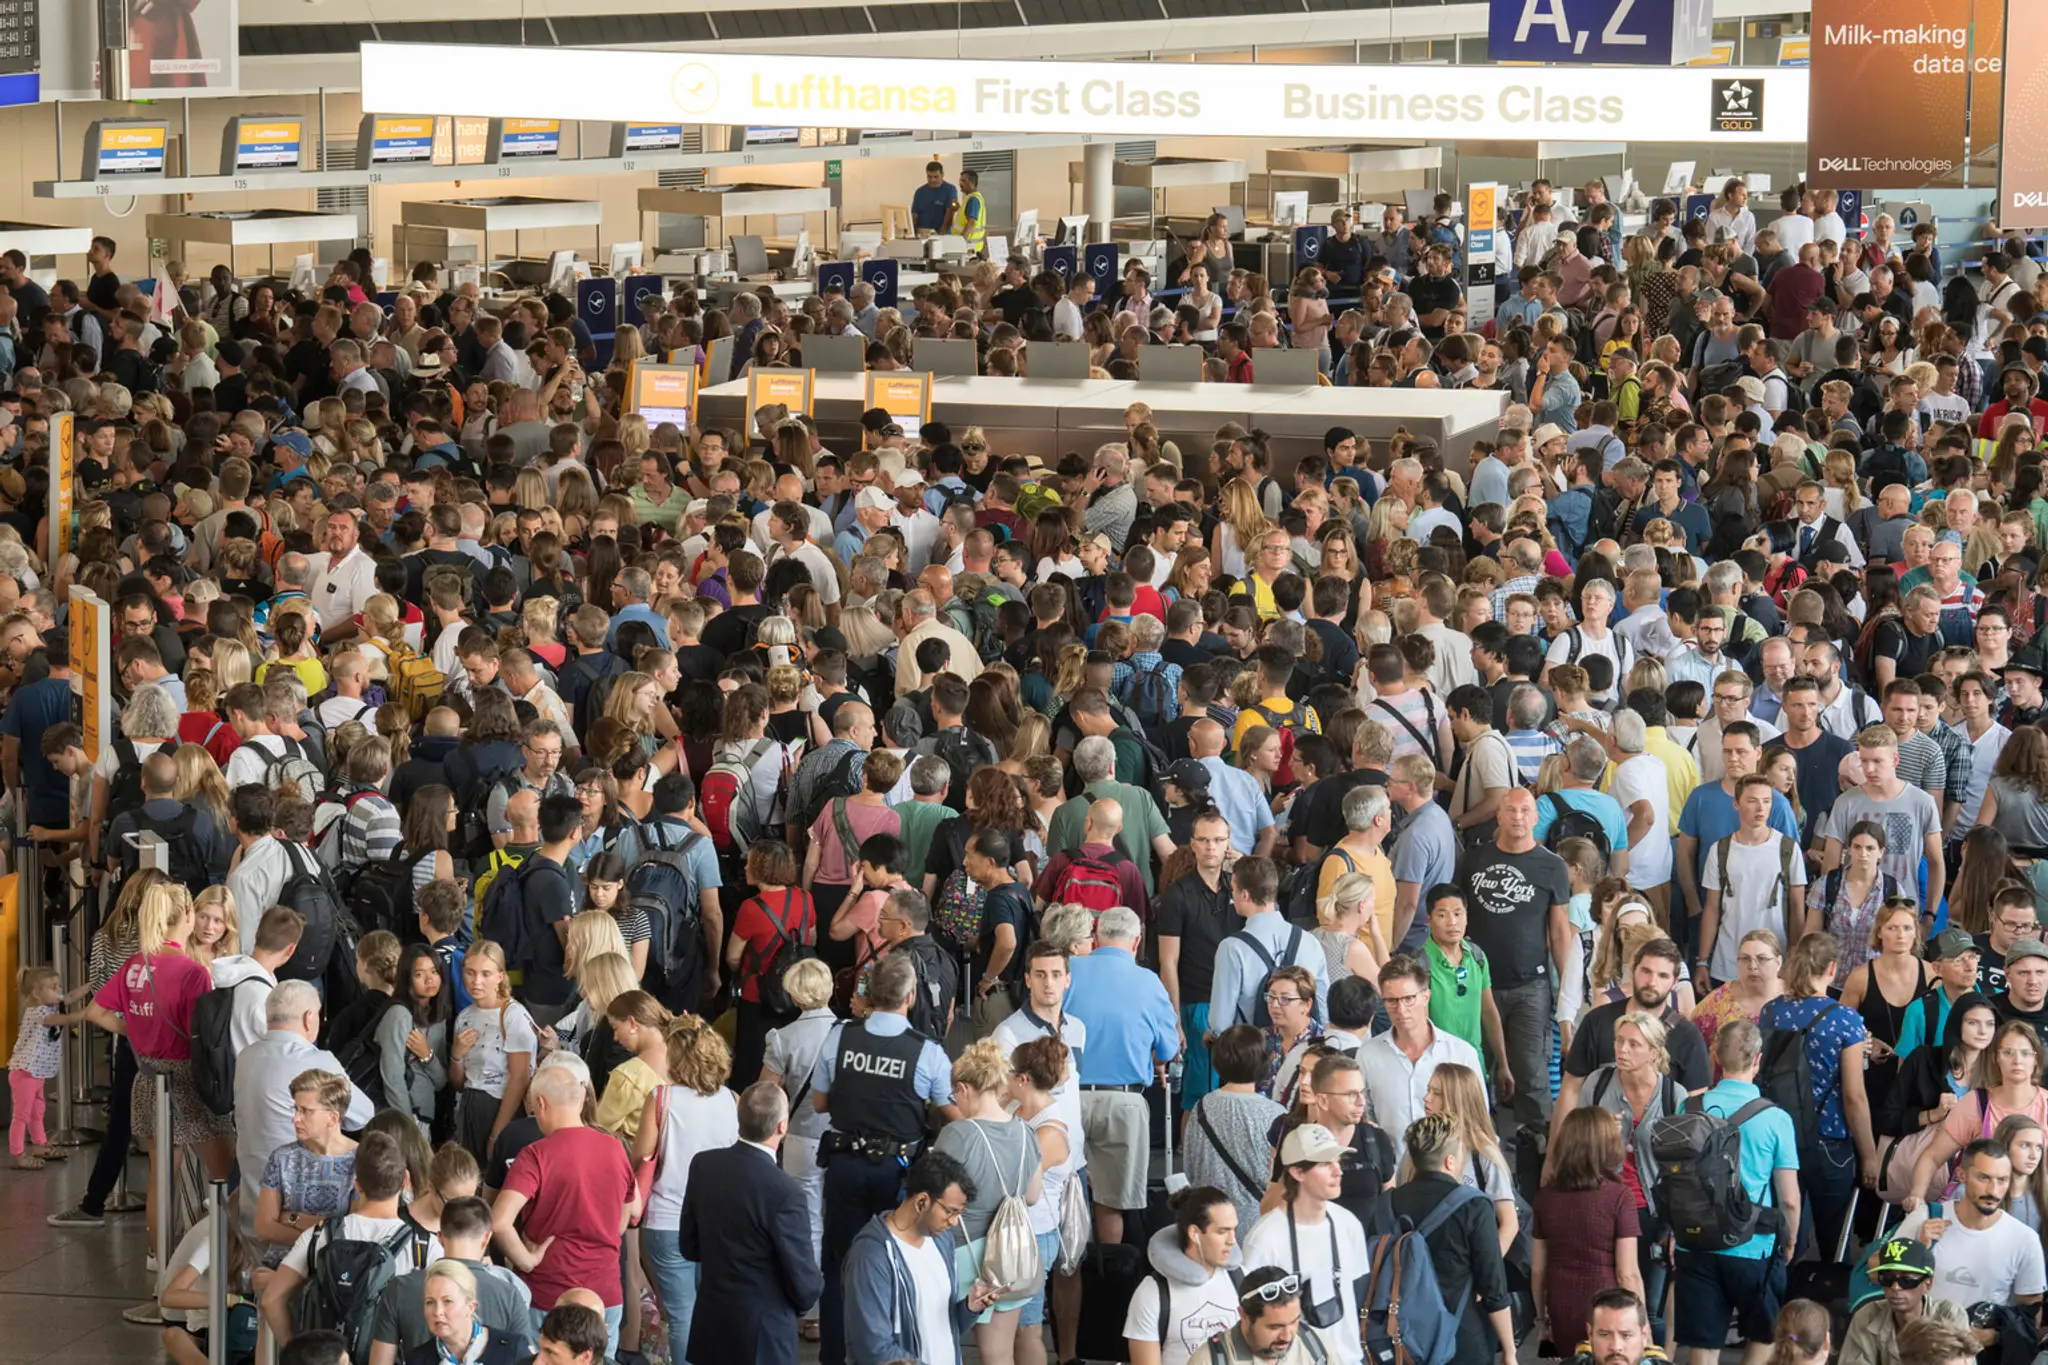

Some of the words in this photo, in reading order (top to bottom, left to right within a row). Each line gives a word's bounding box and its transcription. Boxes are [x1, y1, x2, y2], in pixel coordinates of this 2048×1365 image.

[1825, 24, 1967, 49] Milk-making
[1913, 54, 1965, 74] data
[751, 73, 957, 113] Lufthansa
[975, 78, 1070, 115] First
[1081, 79, 1201, 118] Class
[1283, 83, 1485, 121] Business
[1497, 85, 1624, 123] Class
[1721, 120, 1753, 130] GOLD
[860, 148, 871, 157] 130
[498, 168, 510, 177] 133
[623, 161, 635, 171] 132
[1819, 157, 1861, 172] DELL
[1861, 157, 1952, 174] Technologies
[235, 180, 247, 190] 135
[1471, 872, 1498, 895] New
[1492, 877, 1537, 903] York
[129, 1000, 154, 1017] Staff
[843, 1050, 907, 1079] POLIZEI
[1884, 1241, 1908, 1261] NY
